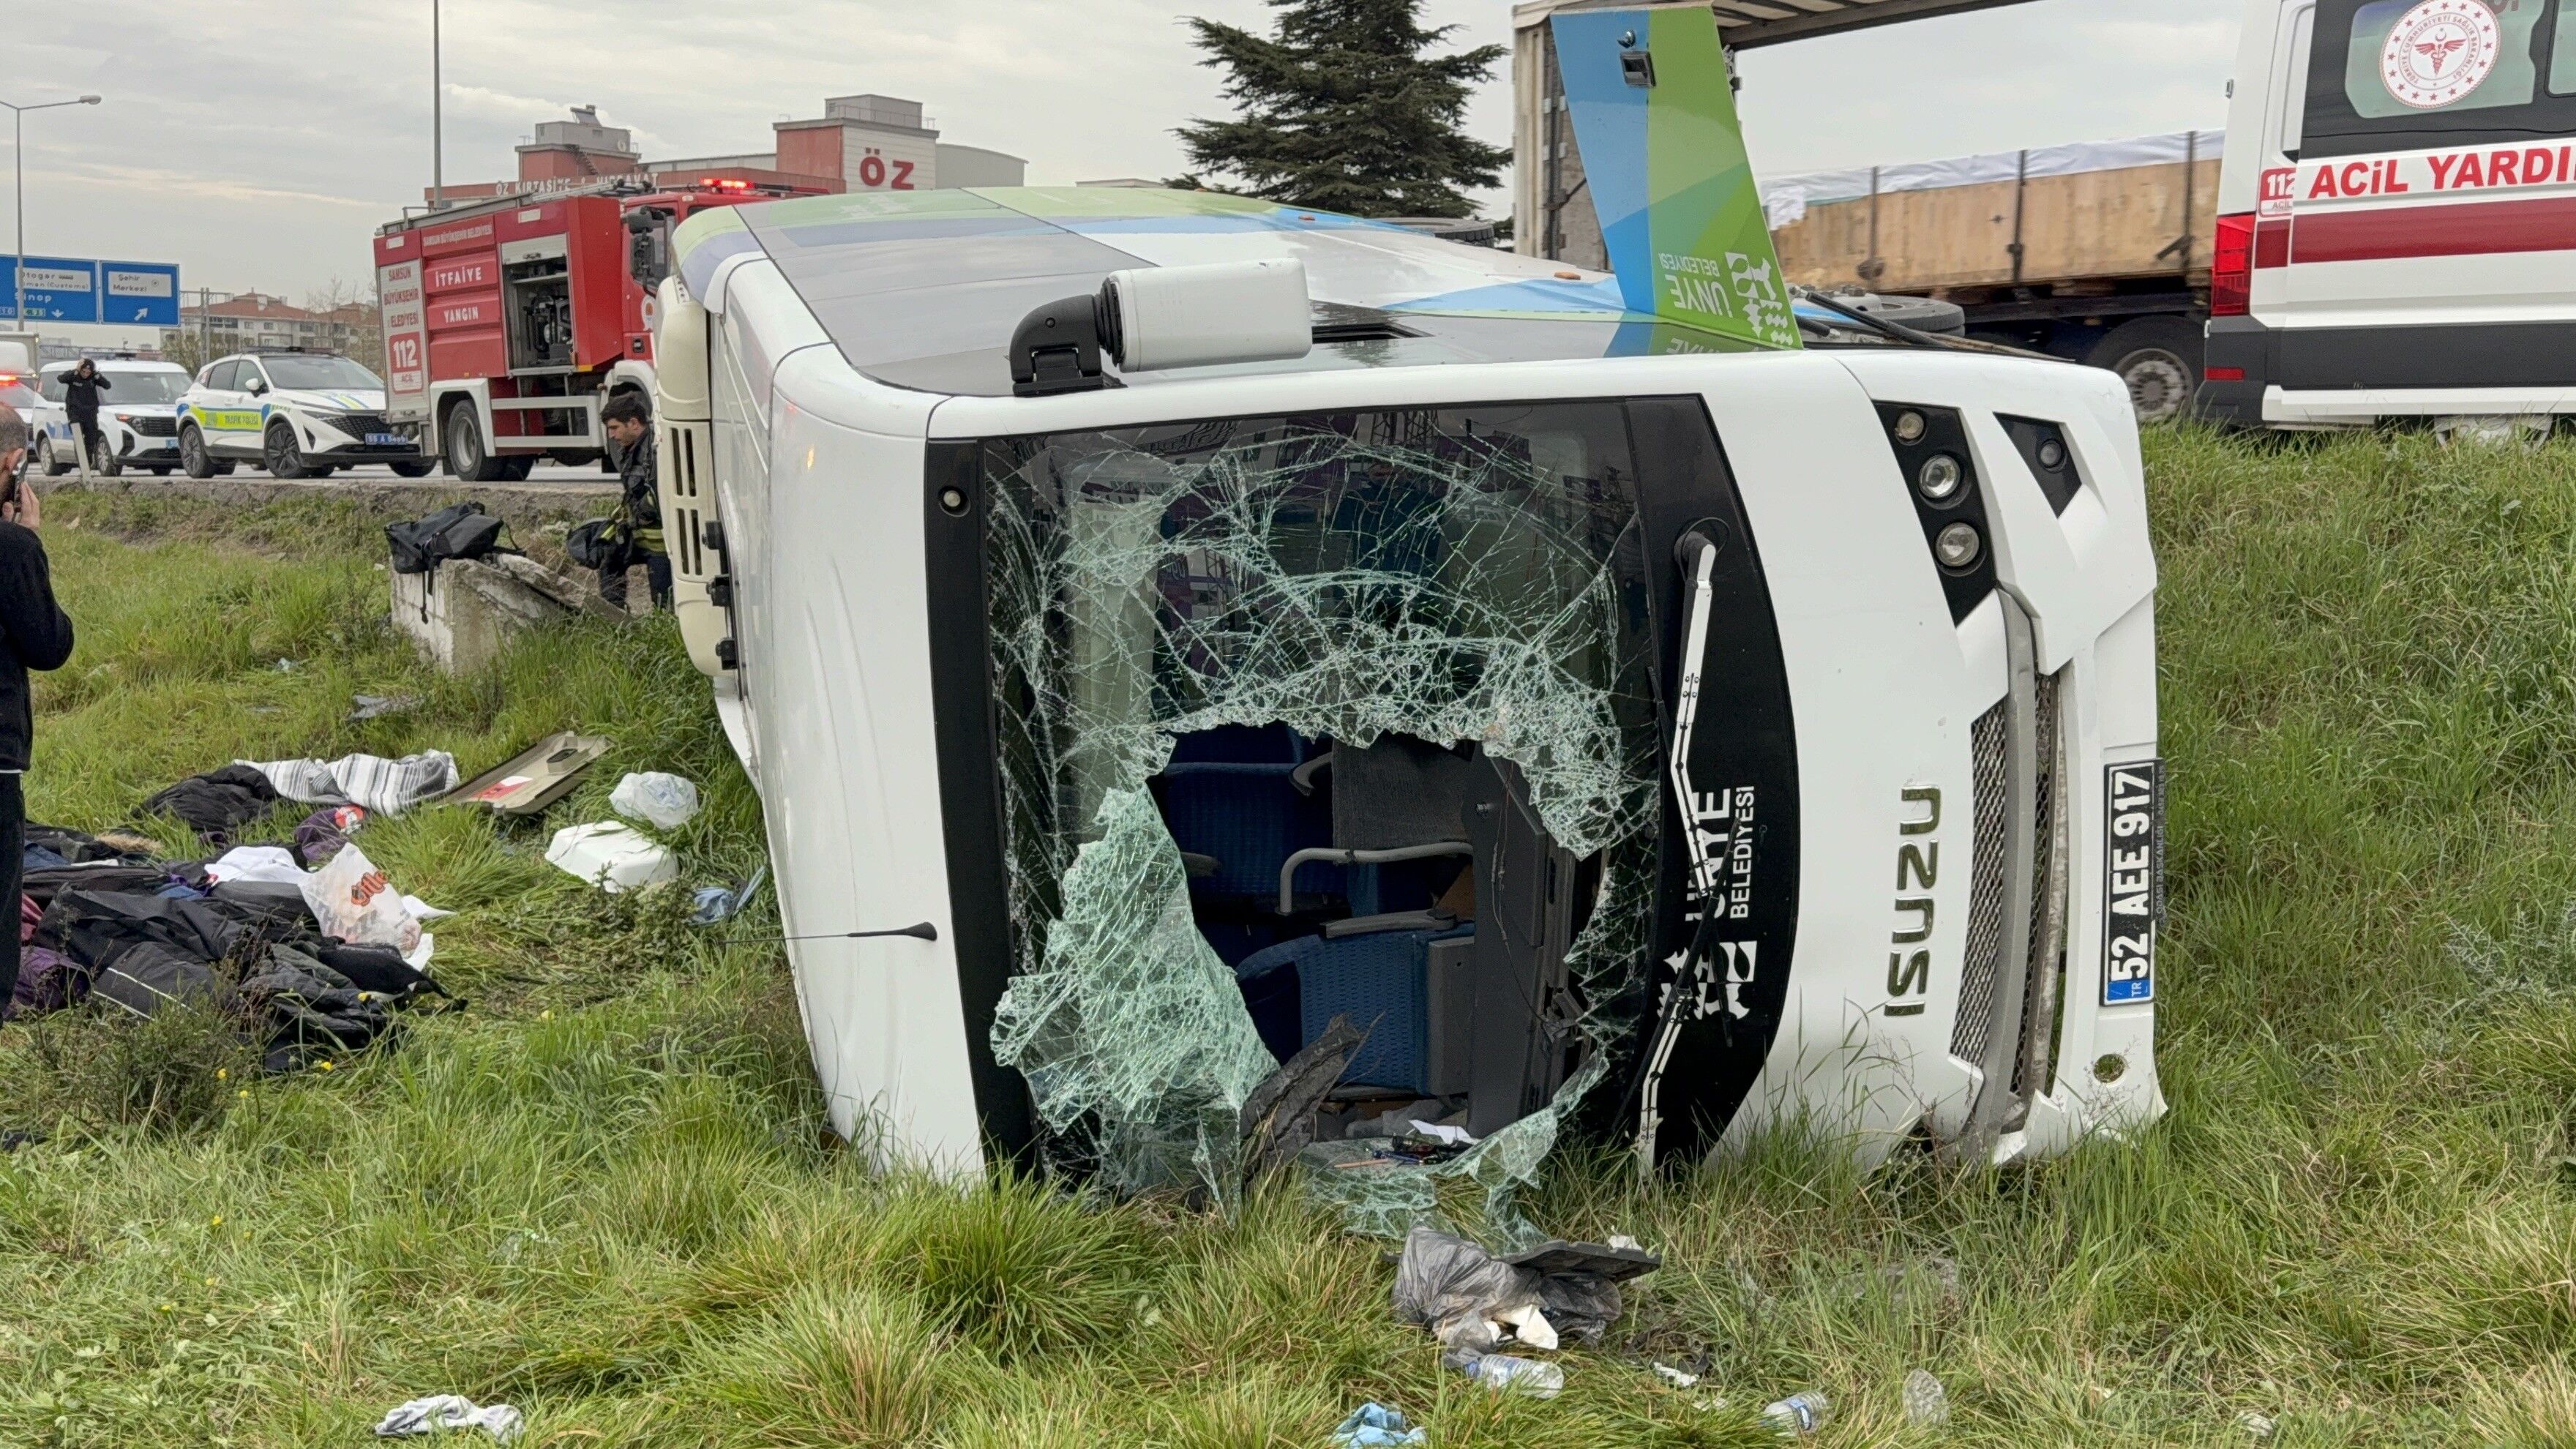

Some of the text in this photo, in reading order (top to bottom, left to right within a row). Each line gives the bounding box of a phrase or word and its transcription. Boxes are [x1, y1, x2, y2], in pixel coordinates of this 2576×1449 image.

[860, 147, 914, 190] ÖZ
[2427, 146, 2576, 190] YARDI
[495, 180, 509, 195] ÖZ
[2267, 173, 2295, 196] 112
[389, 266, 411, 281] SAMSUN
[435, 266, 482, 288] İTFAİYE
[387, 310, 419, 329] ELEDİYESİ
[443, 306, 479, 323] YANGIN
[393, 339, 418, 369] 112
[2111, 771, 2150, 981] 52 AEE 917
[1884, 785, 1941, 1016] ISUZU
[2131, 981, 2142, 997] TR
